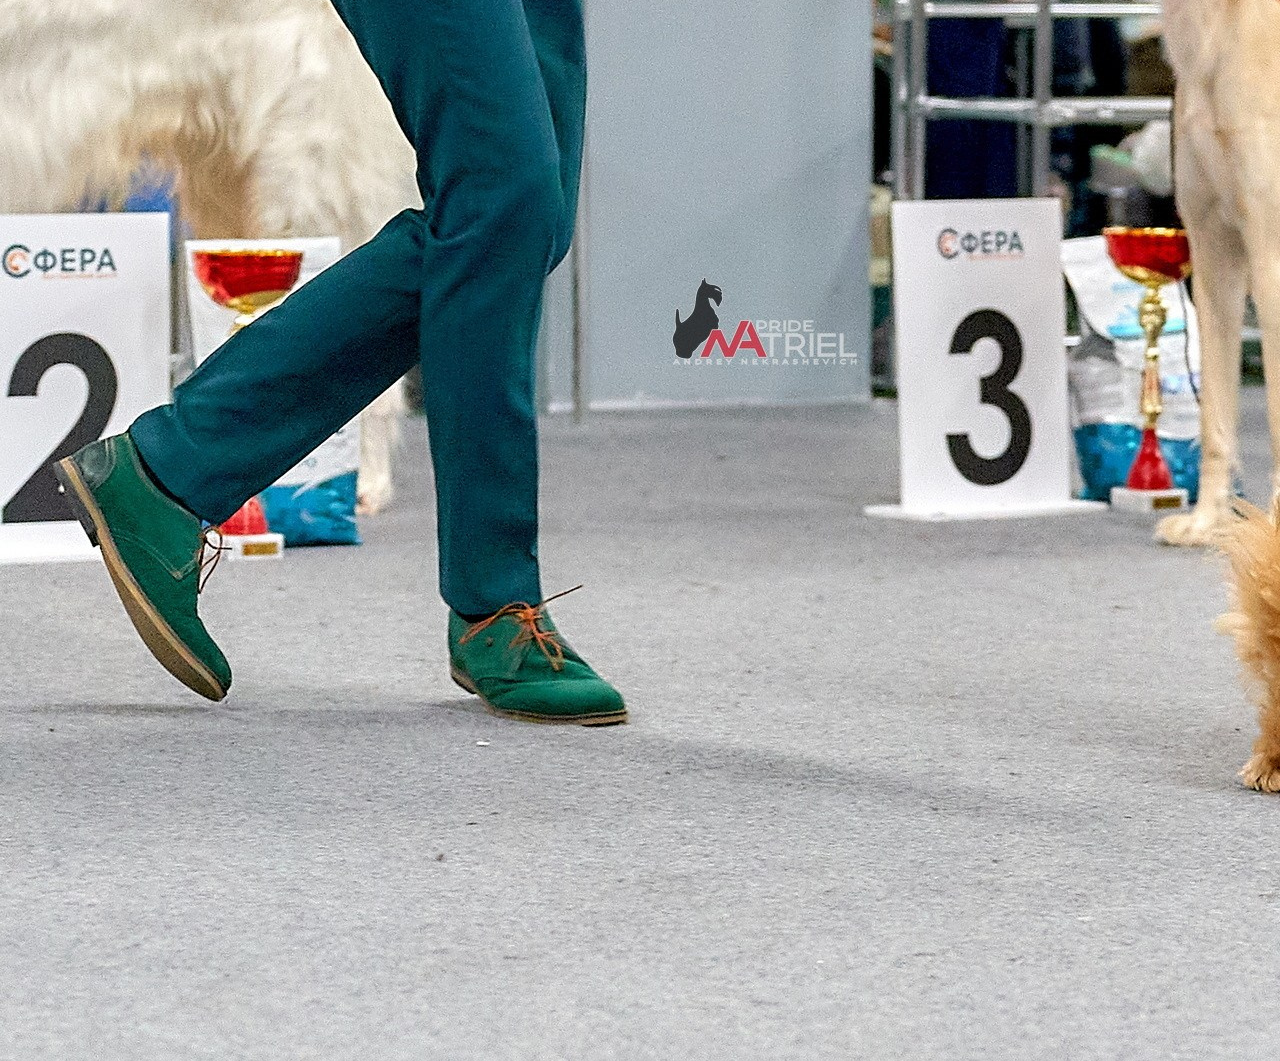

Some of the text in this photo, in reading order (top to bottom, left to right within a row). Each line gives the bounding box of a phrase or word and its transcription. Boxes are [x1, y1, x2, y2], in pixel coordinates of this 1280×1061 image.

[2, 244, 118, 278] СФЕРА
[937, 228, 1024, 259] СФЕРА
[2, 332, 118, 523] 2
[945, 307, 1034, 487] 3
